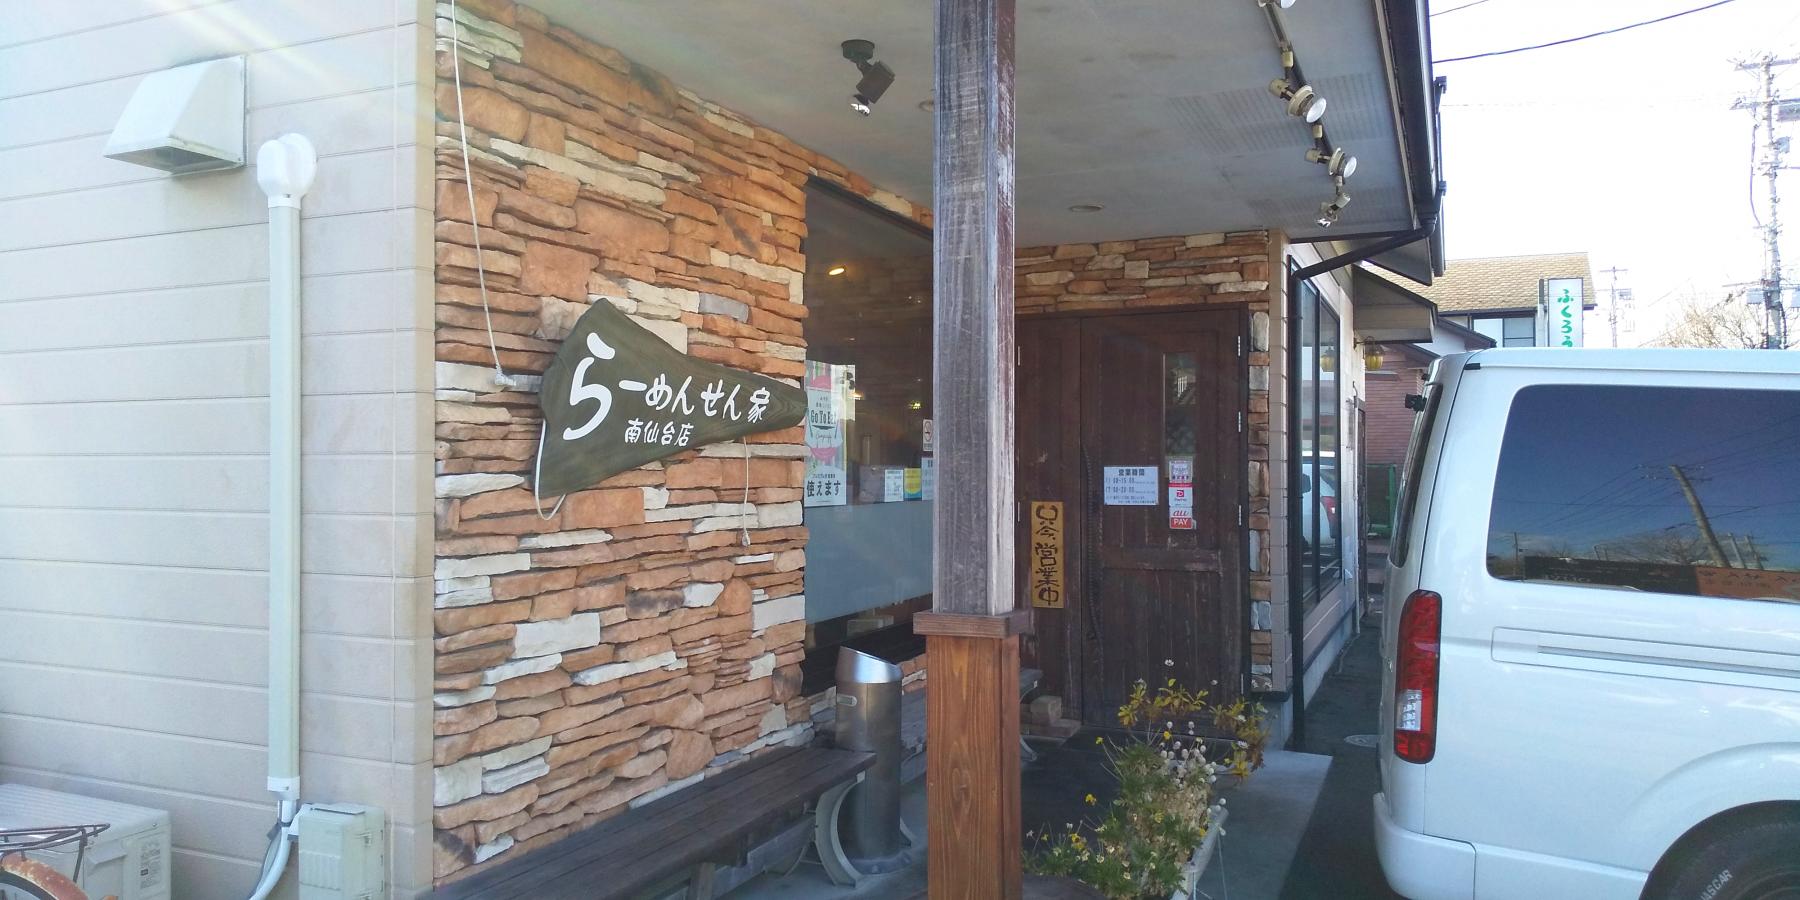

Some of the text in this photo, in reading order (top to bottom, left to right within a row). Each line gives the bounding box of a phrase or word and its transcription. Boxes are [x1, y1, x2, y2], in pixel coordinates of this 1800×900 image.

[563, 332, 771, 441] らーめんせん家
[624, 418, 695, 447] 南仙台店
[806, 480, 841, 498] 使えます
[1699, 868, 1734, 900] ASCAR
